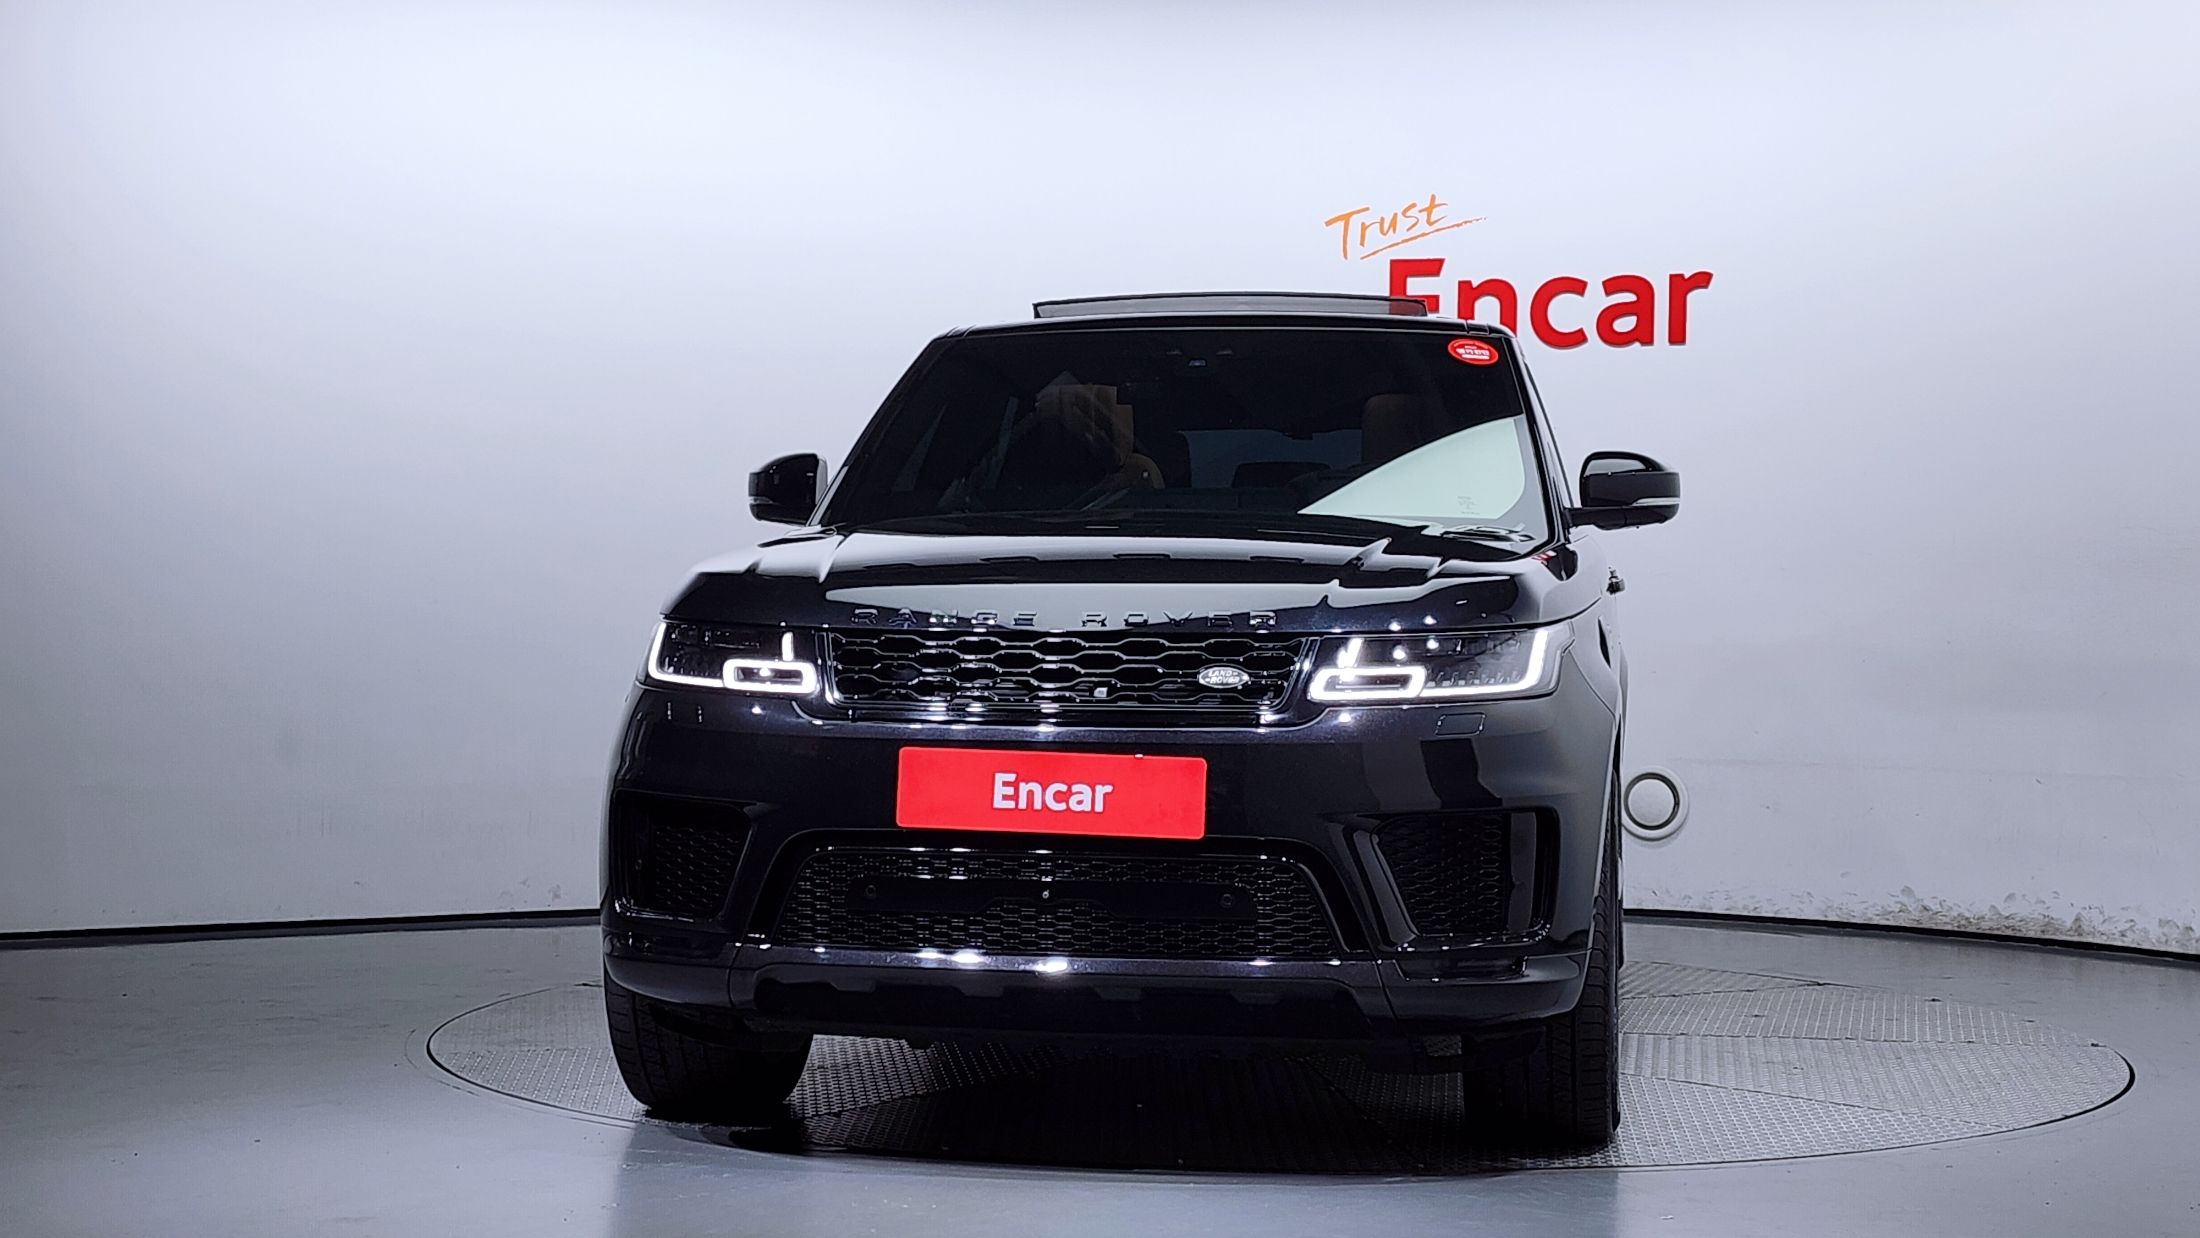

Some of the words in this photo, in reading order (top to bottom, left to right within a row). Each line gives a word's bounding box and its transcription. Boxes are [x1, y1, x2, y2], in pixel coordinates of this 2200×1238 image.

[1325, 194, 1449, 260] Trust
[1389, 258, 1714, 348] Encar
[851, 608, 1037, 629] RANGE
[1081, 610, 1277, 629] ROVER
[993, 772, 1113, 813] Encar
